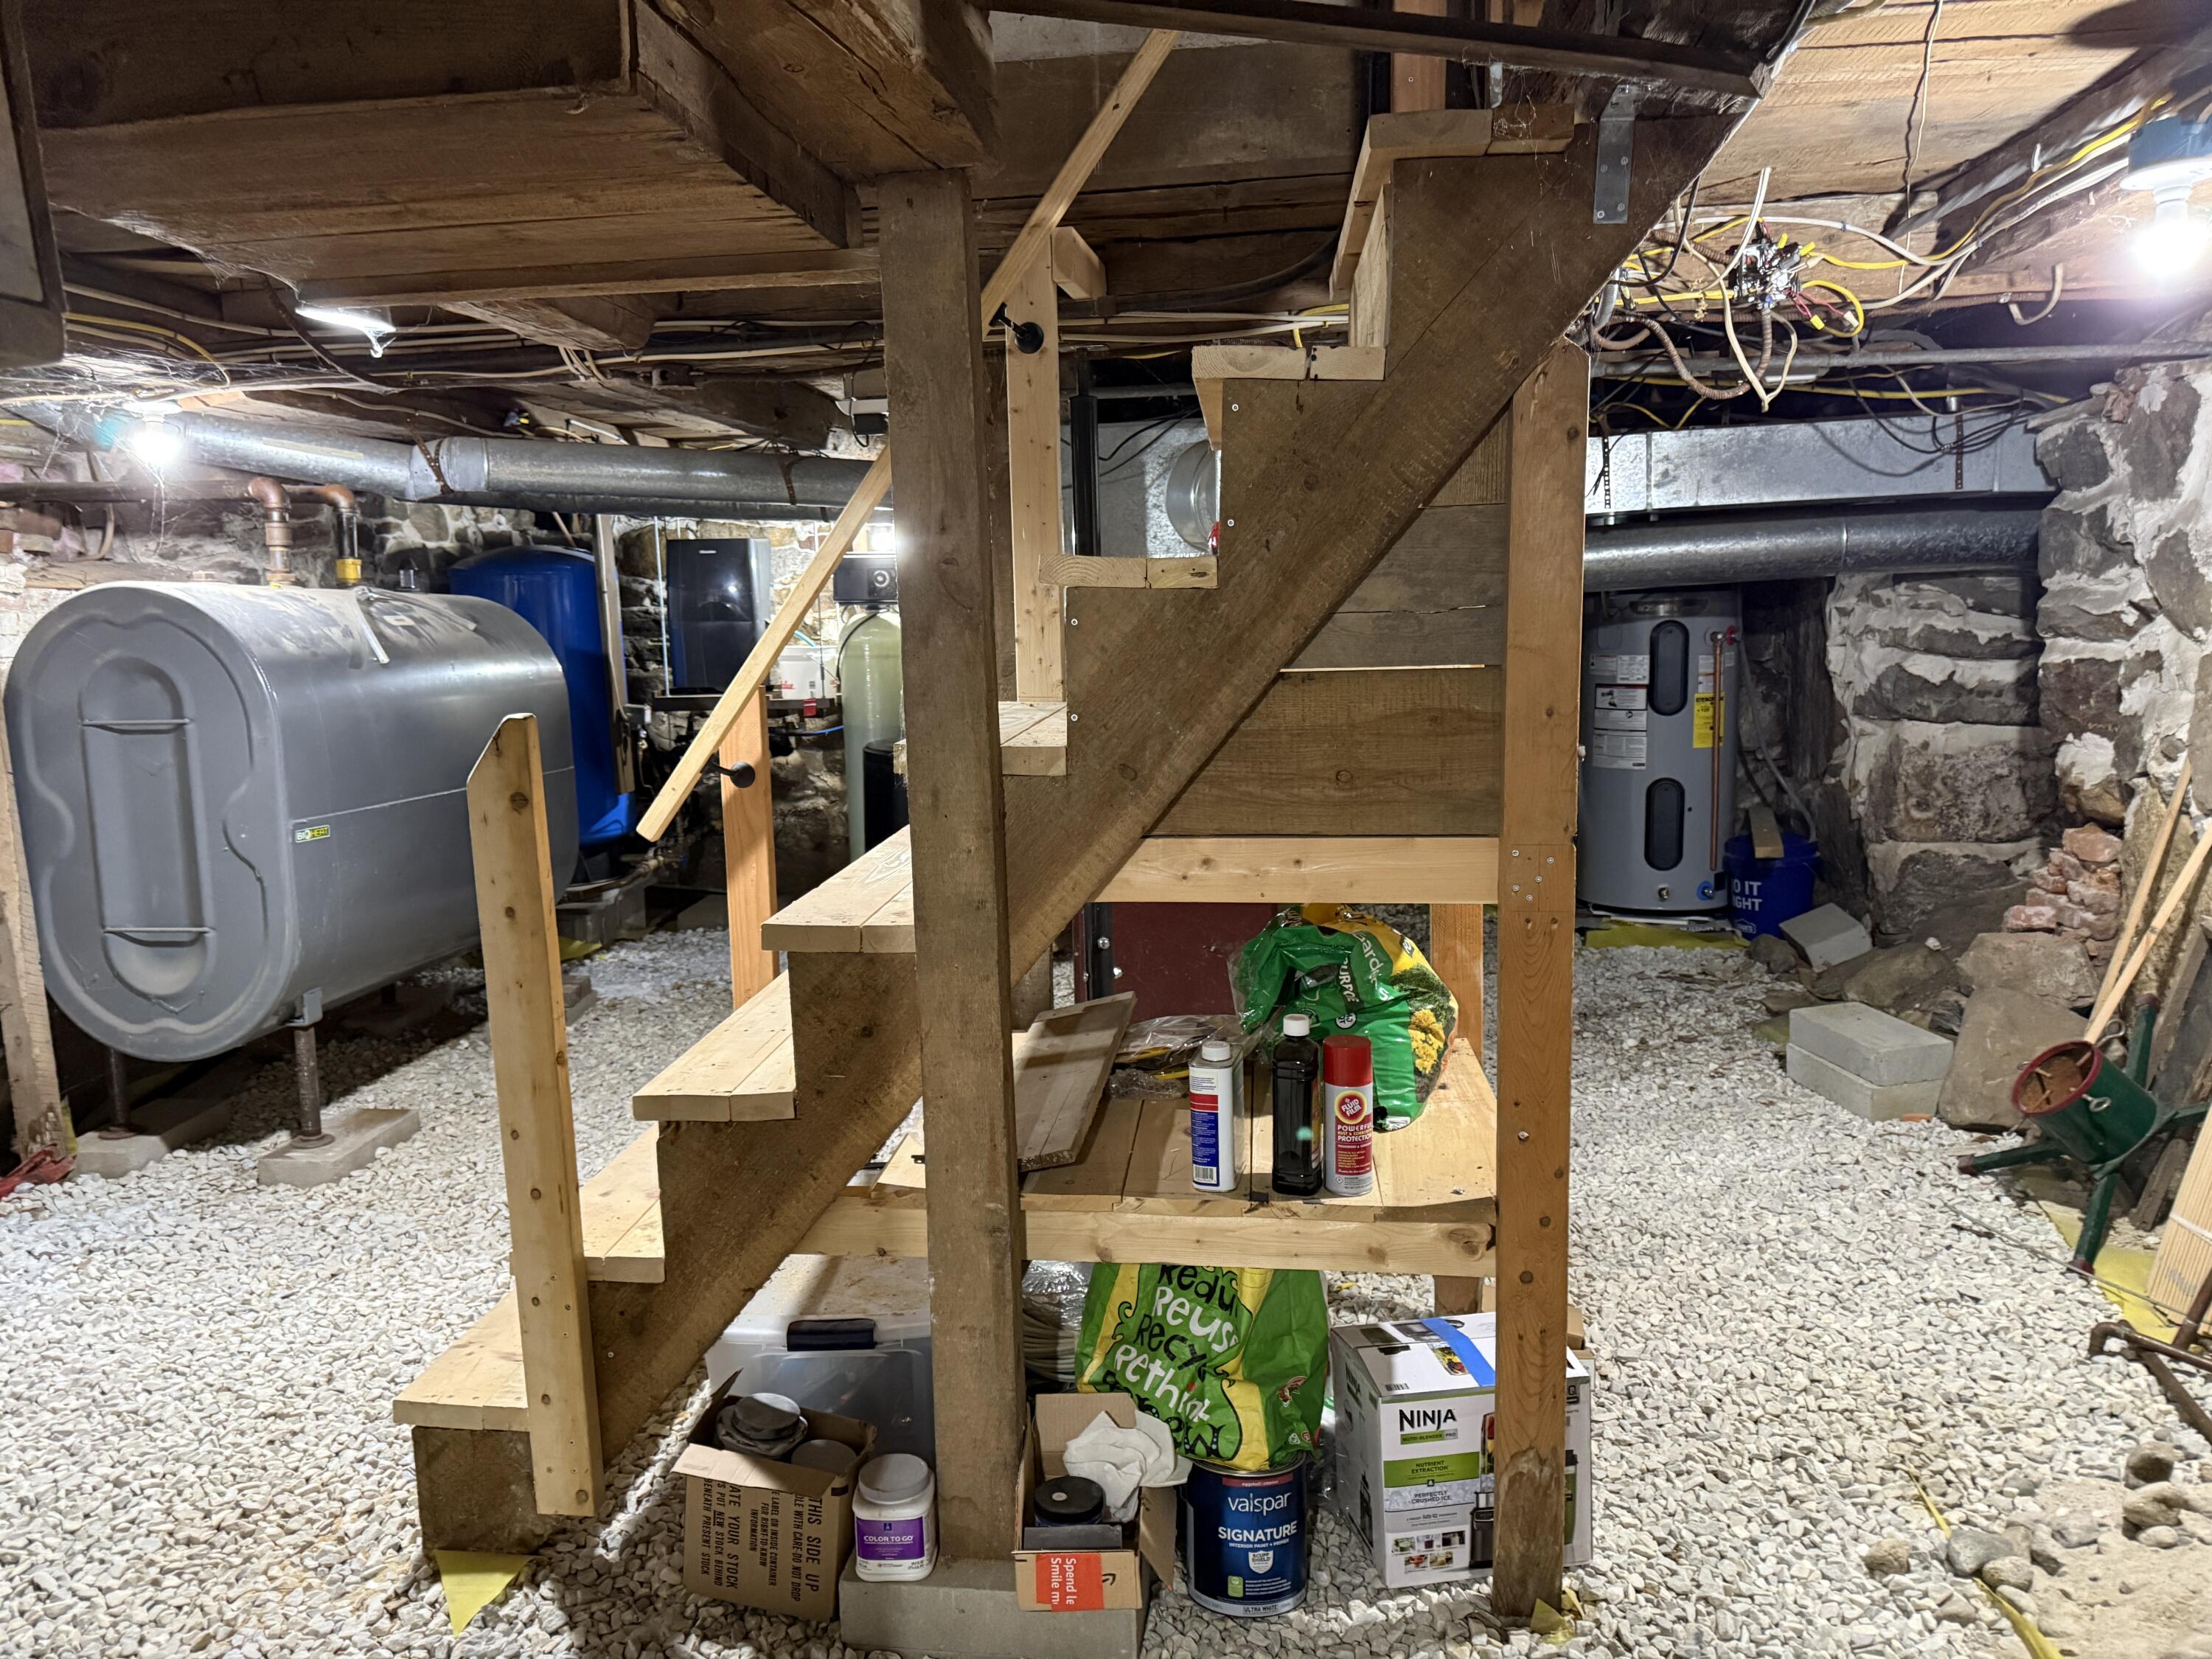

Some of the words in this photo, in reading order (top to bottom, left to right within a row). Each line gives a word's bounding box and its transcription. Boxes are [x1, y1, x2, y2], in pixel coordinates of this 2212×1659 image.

[1733, 879, 1741, 893] O
[1745, 880, 1762, 896] IT
[1732, 894, 1763, 911] IGHT
[1341, 1099, 1360, 1112] FLUID
[1346, 1105, 1362, 1117] FILM
[1114, 1344, 1211, 1422] Rethink
[1399, 1408, 1457, 1431] NINJA
[1411, 1465, 1448, 1474] EXTRACTION
[1416, 1460, 1444, 1468] NUTRIENT
[703, 1478, 712, 1512] BENEATH
[716, 1492, 726, 1506] PUT
[771, 1497, 779, 1515] LABEL
[1228, 1492, 1292, 1516] valspar
[1411, 1496, 1439, 1504] CRUSHED
[760, 1502, 769, 1514] FOR
[807, 1498, 823, 1525] THIS
[715, 1511, 725, 1528] NEW
[727, 1516, 740, 1545] YOUR
[749, 1509, 758, 1552] INFORMATION
[771, 1518, 779, 1528] ON
[793, 1510, 804, 1529] WITH
[701, 1515, 712, 1549] PRESENT
[759, 1517, 768, 1567] RIGHT-TO-KNOW
[770, 1529, 779, 1551] INSIDE
[1218, 1520, 1298, 1543] SIGNATURE
[714, 1531, 724, 1556] STOCK
[806, 1536, 821, 1565] SIDE
[701, 1552, 710, 1576] STOCK
[714, 1559, 723, 1586] BEHIND
[726, 1554, 739, 1589] STOCK
[768, 1552, 778, 1586] CONTAINER
[791, 1565, 801, 1579] NOT
[1051, 1557, 1062, 1588] Smile
[1063, 1558, 1077, 1592] Spend
[790, 1582, 801, 1602] DROP
[804, 1573, 820, 1592] UP
[1051, 1592, 1060, 1604] m
[1066, 1596, 1077, 1604] le
